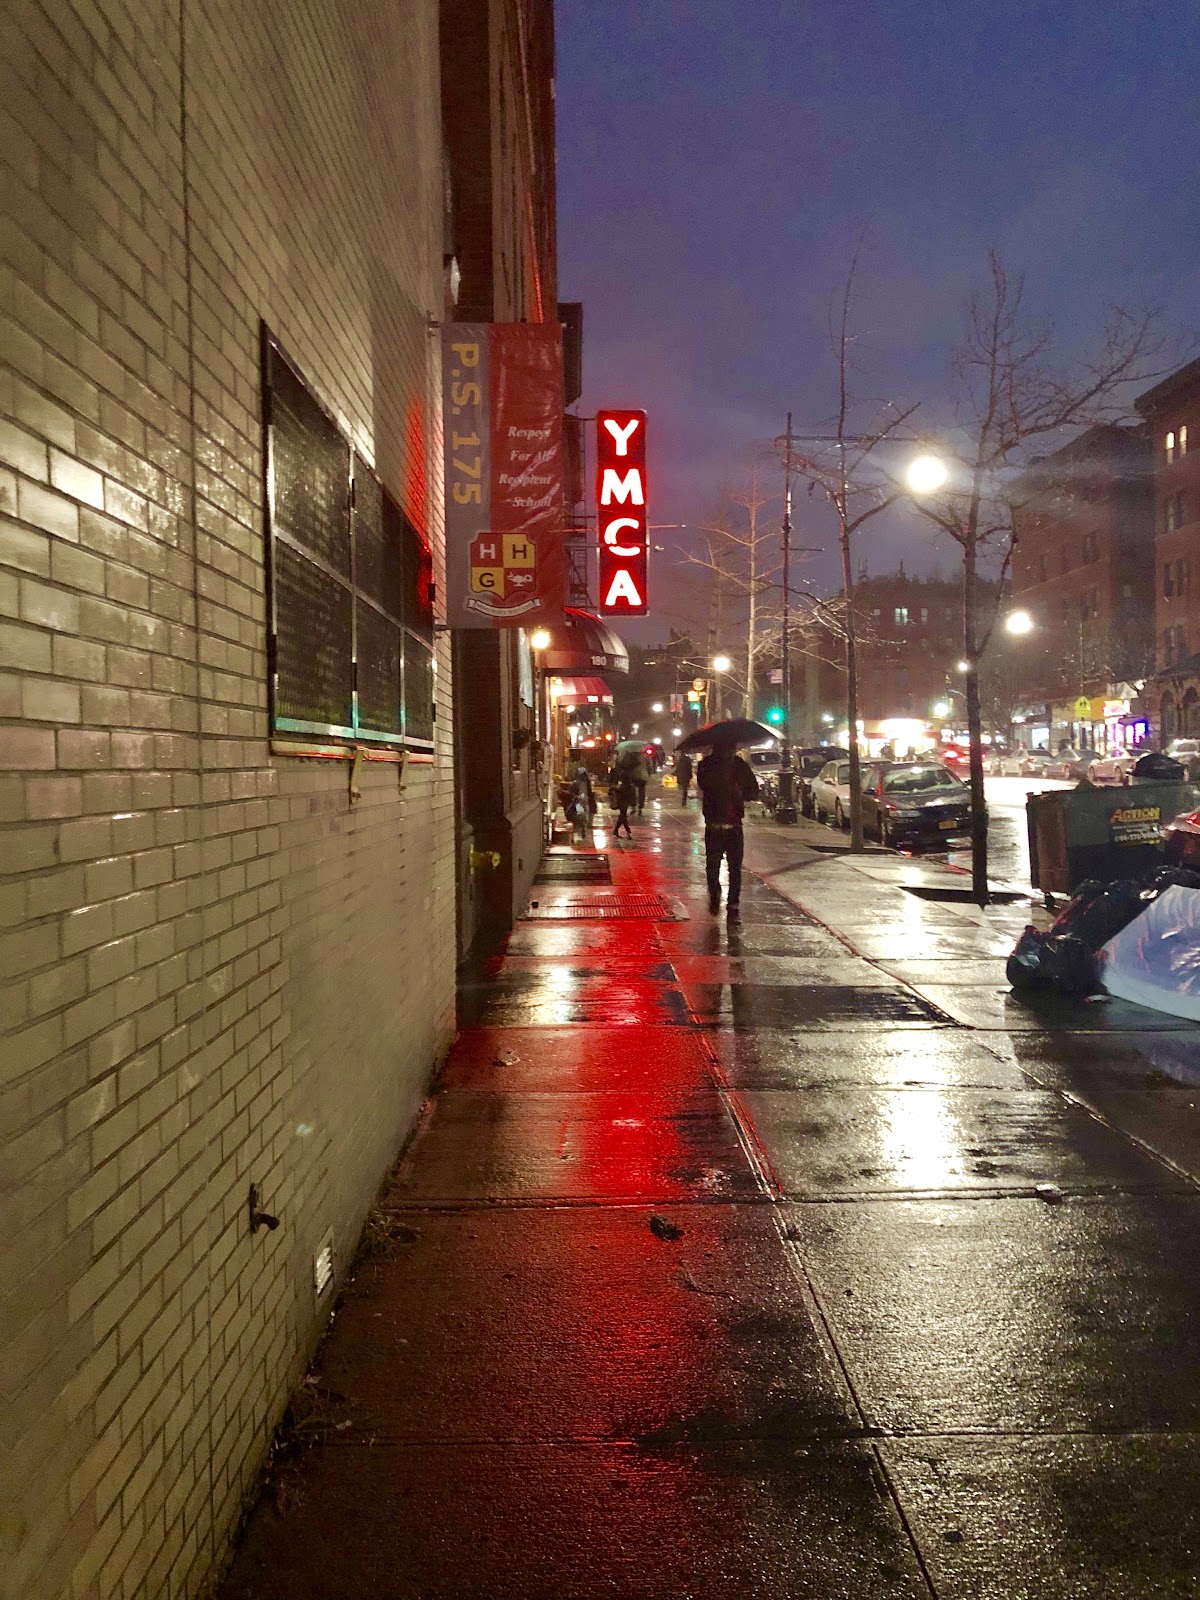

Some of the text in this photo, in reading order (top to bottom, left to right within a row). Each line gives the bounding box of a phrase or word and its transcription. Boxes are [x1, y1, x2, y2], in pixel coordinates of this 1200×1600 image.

[451, 343, 481, 505] P.S. 175
[508, 426, 552, 440] Respect
[510, 450, 532, 461] For
[499, 473, 552, 487] Recipient
[512, 496, 552, 508] School
[601, 419, 644, 606] YMCA
[479, 543, 528, 560] H H
[479, 572, 495, 588] G
[590, 655, 607, 667] 180
[1110, 807, 1161, 823] ACTION
